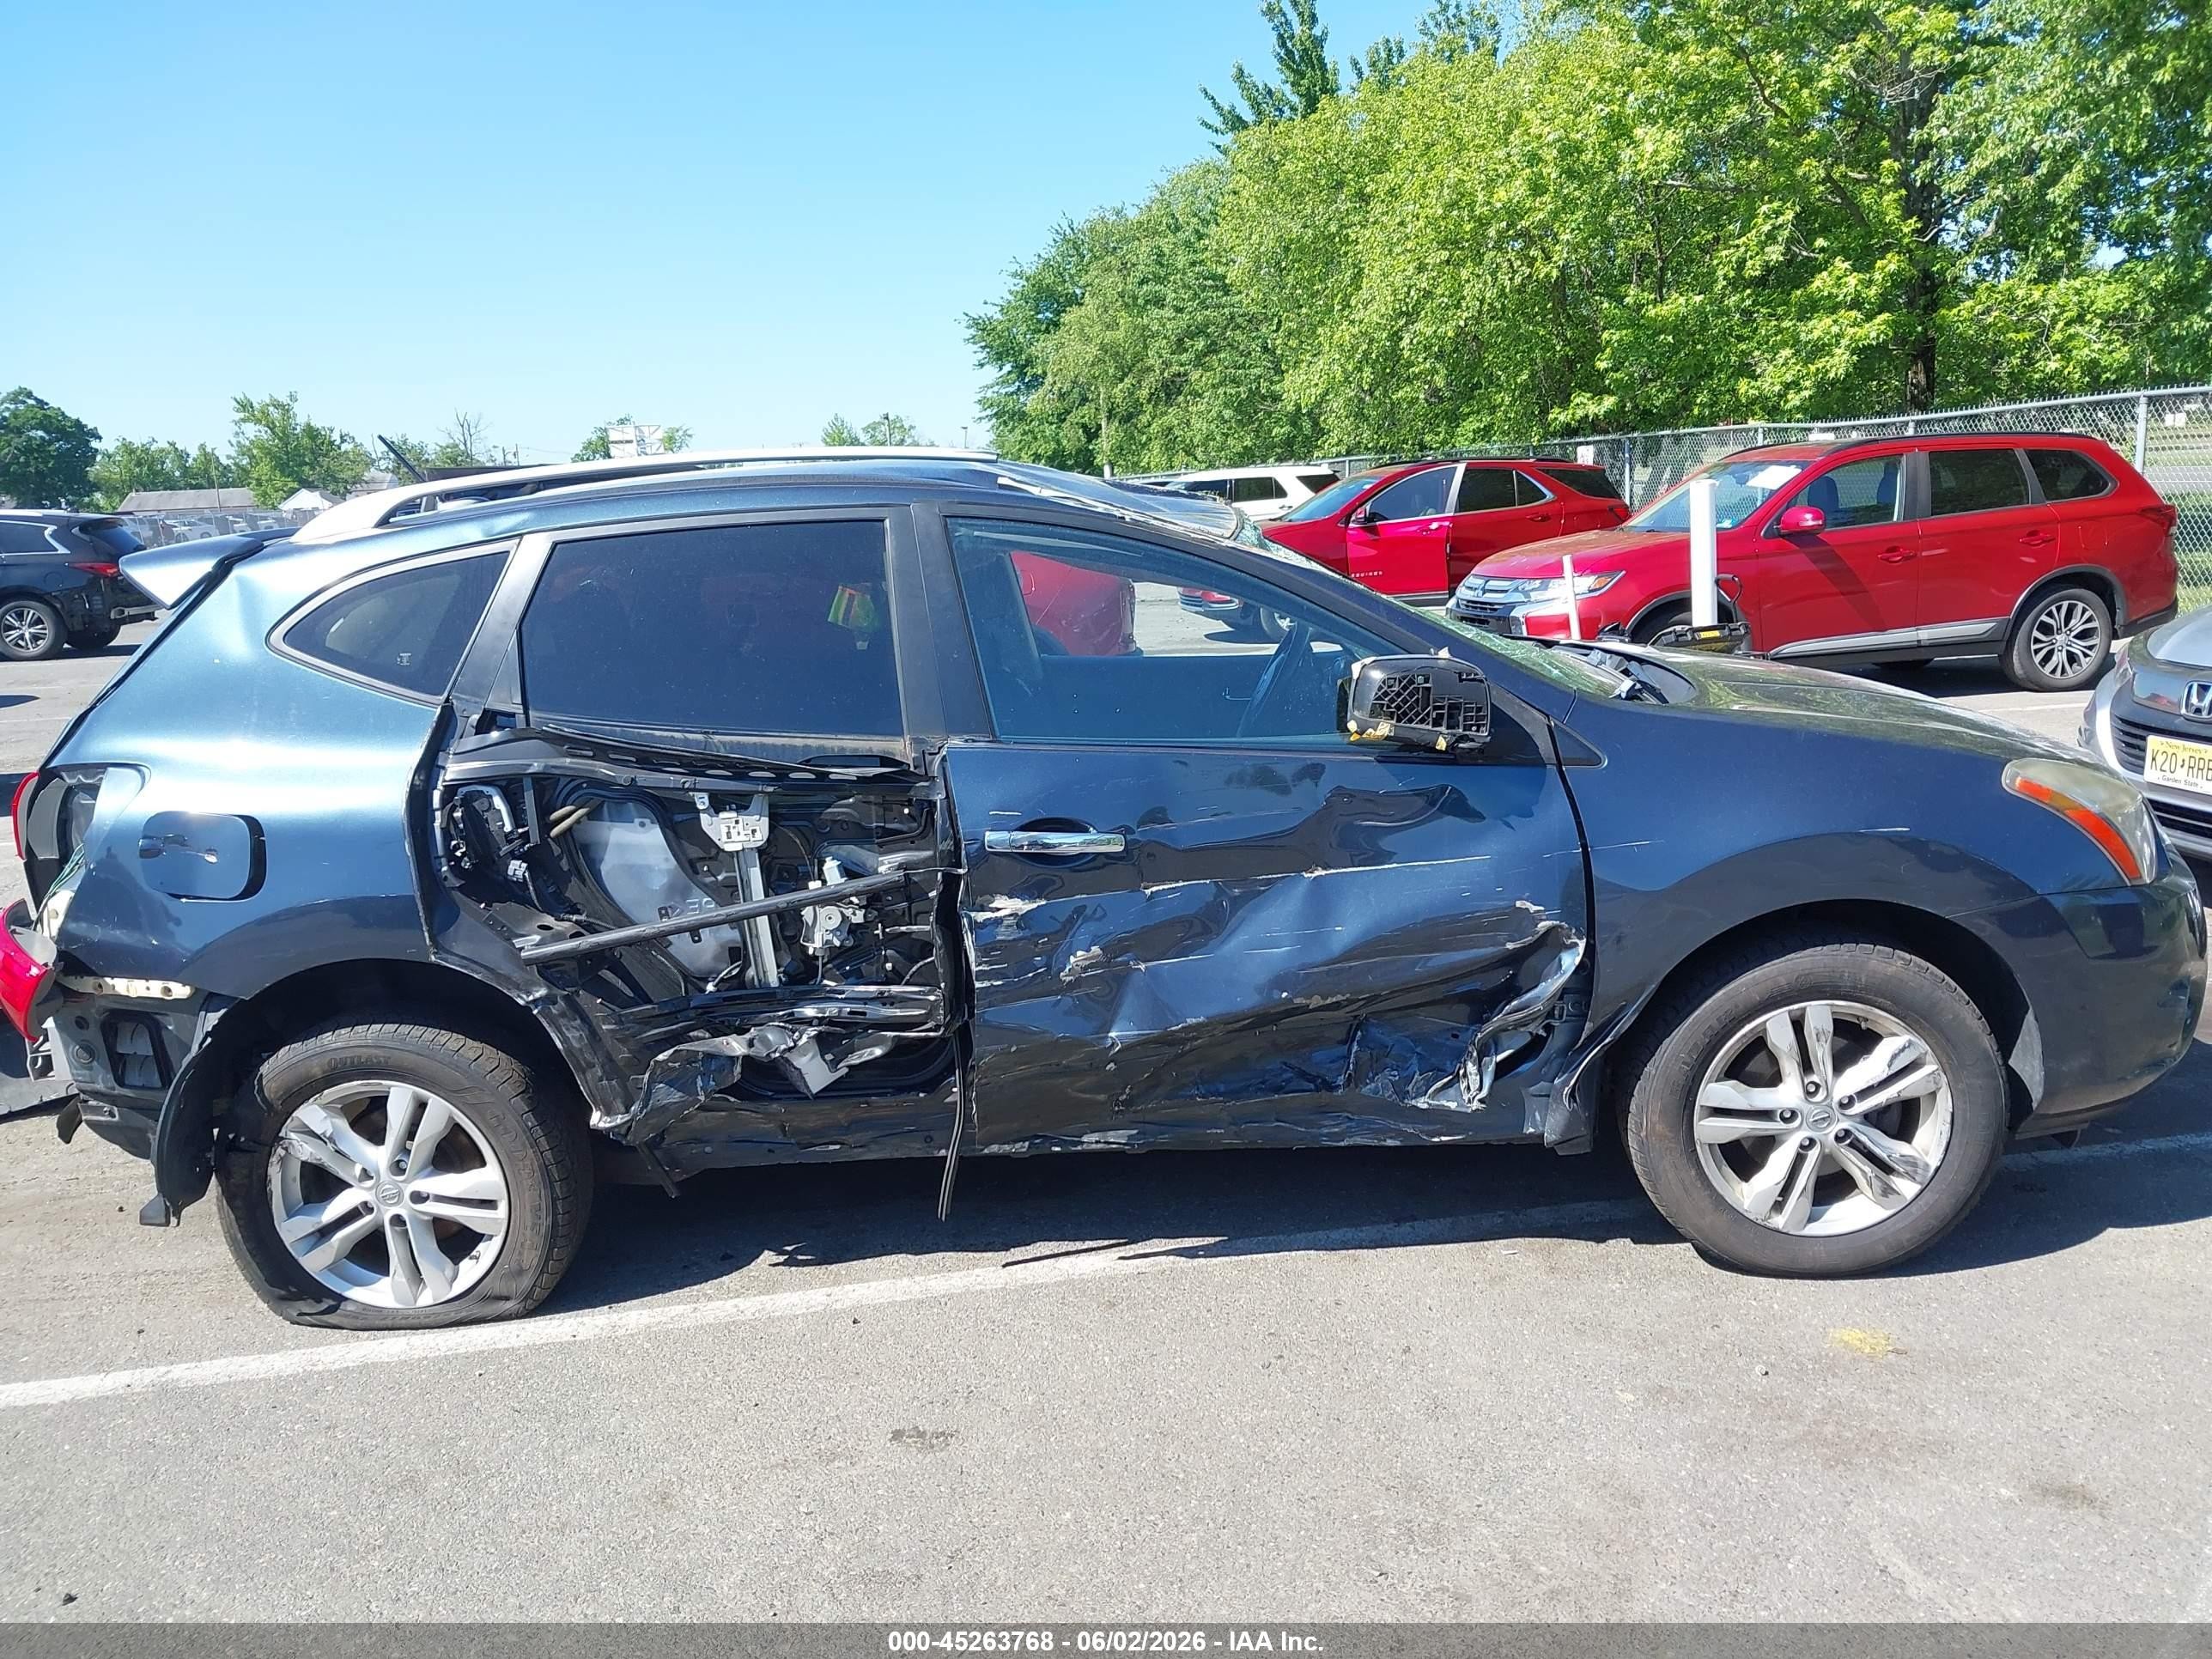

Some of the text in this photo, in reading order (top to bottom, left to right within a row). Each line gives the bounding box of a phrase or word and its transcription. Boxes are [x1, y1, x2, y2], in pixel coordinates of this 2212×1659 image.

[2165, 740, 2203, 754] New Jersey
[2161, 775, 2199, 788] Garden State
